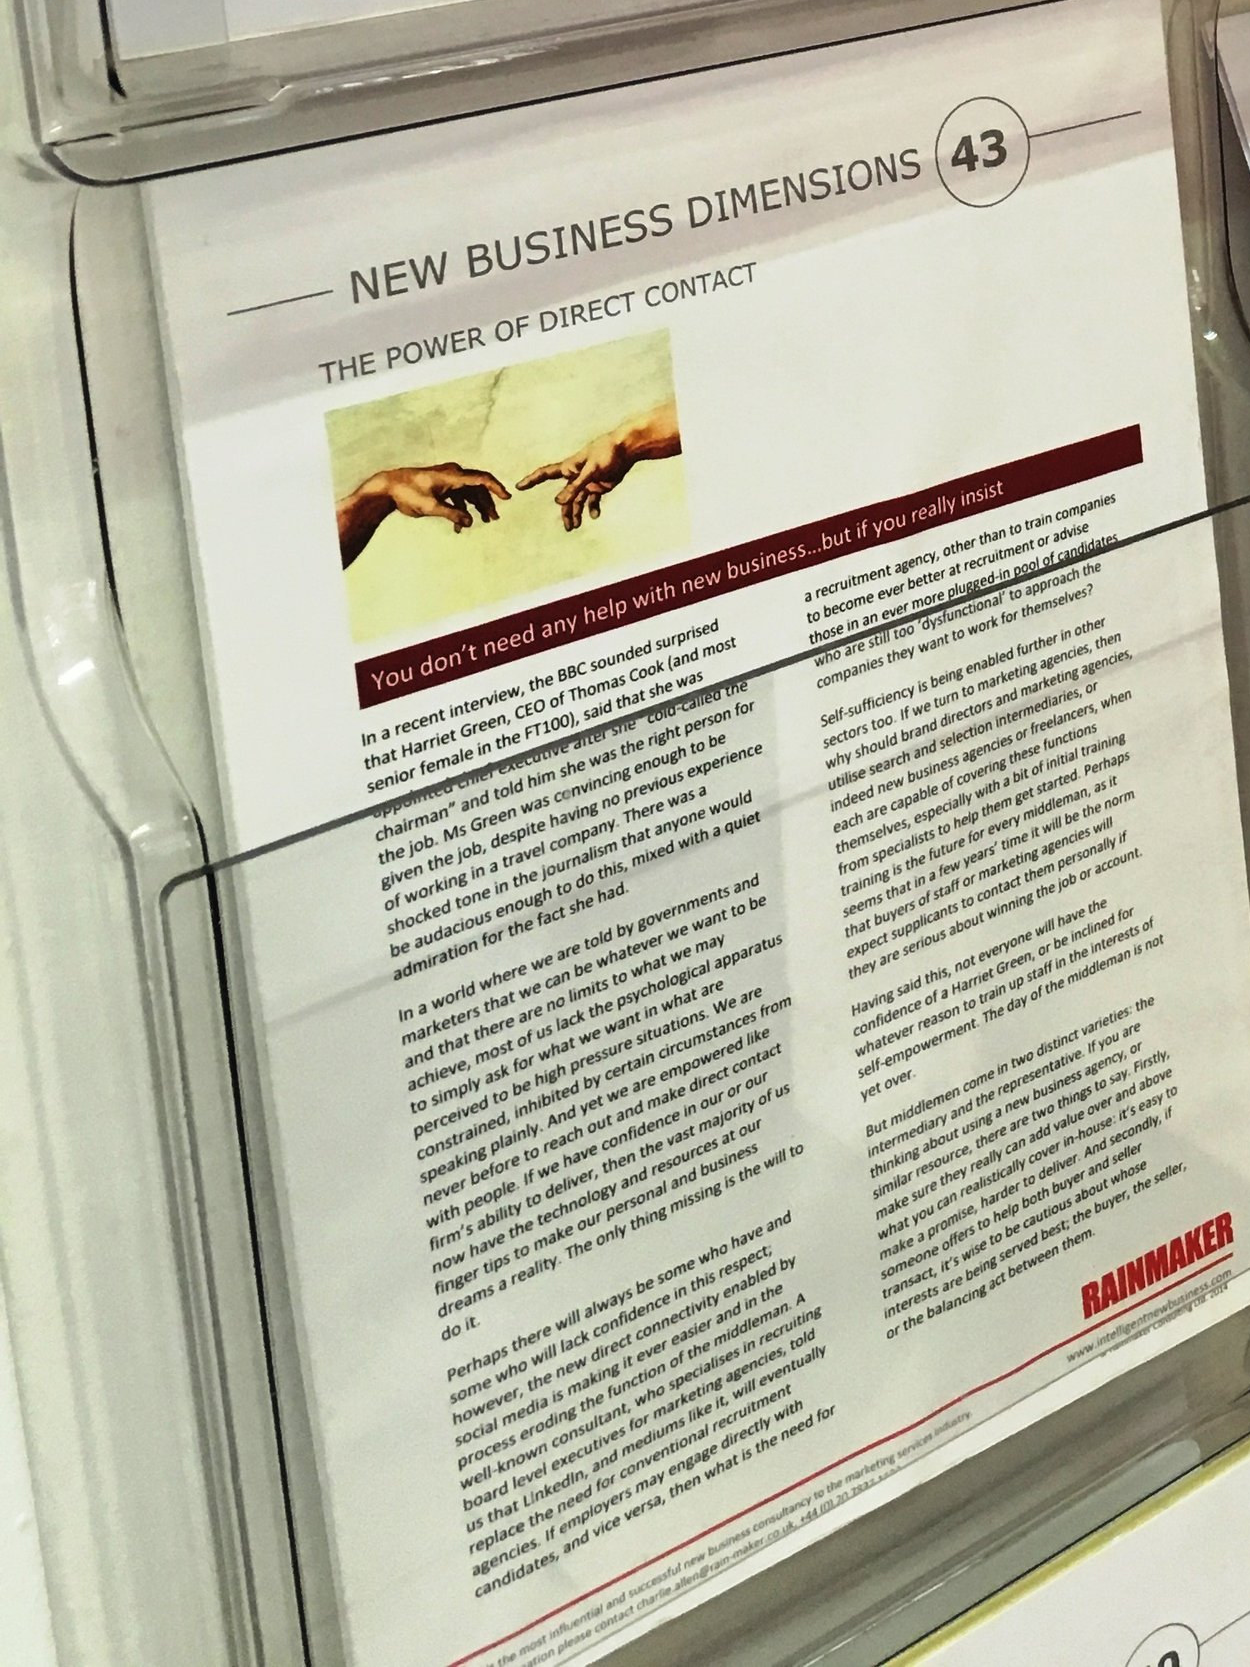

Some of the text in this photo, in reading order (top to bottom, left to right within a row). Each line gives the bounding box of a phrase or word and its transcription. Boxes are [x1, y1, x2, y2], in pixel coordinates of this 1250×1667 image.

[350, 128, 1008, 303] NEW BUSINESS DIMENSIONS 43
[318, 261, 756, 383] THE POWER OF DIRECT CONTACT
[370, 666, 412, 690] You
[420, 643, 477, 676] don't
[483, 623, 534, 656] need
[541, 614, 576, 638] any
[583, 598, 626, 624] help
[632, 581, 675, 608] with
[682, 570, 720, 593] new
[856, 518, 867, 538] if
[872, 514, 905, 538] you
[911, 495, 955, 522] really
[961, 480, 1003, 506] insist
[804, 493, 1116, 602] a recruitment agency, other than to train companies
[1081, 1212, 1233, 1319] RAINMAKER
